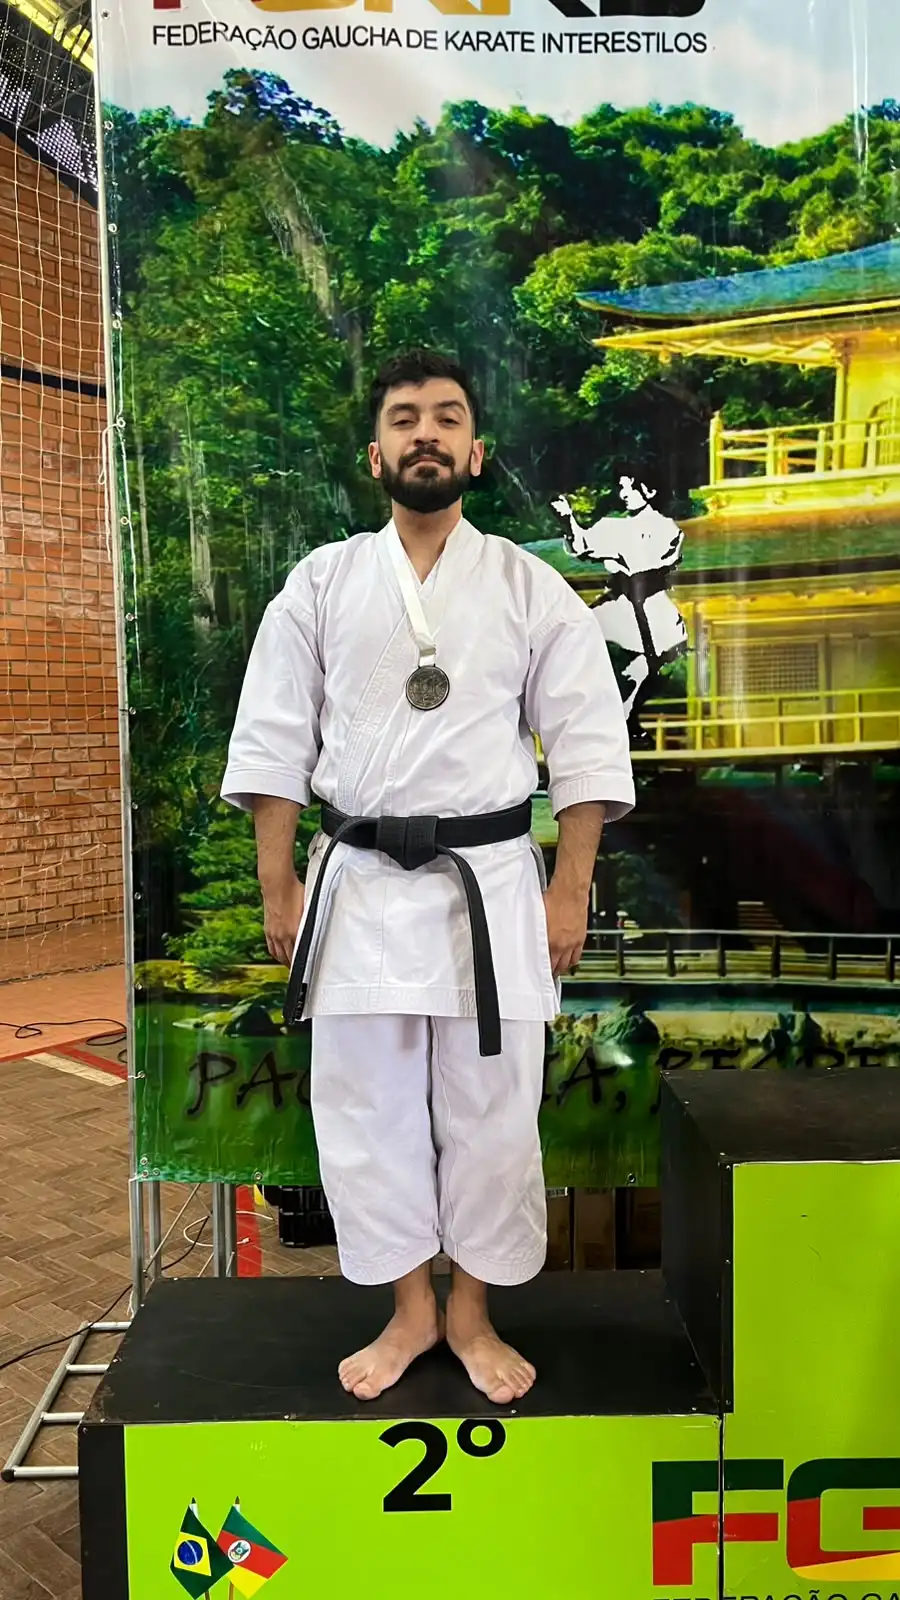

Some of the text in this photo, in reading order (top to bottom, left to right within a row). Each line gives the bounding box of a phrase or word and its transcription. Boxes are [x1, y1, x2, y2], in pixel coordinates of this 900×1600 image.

[153, 21, 707, 53] FEDERAÇÃO GAUCHA DE KARATE INTERESTILOS
